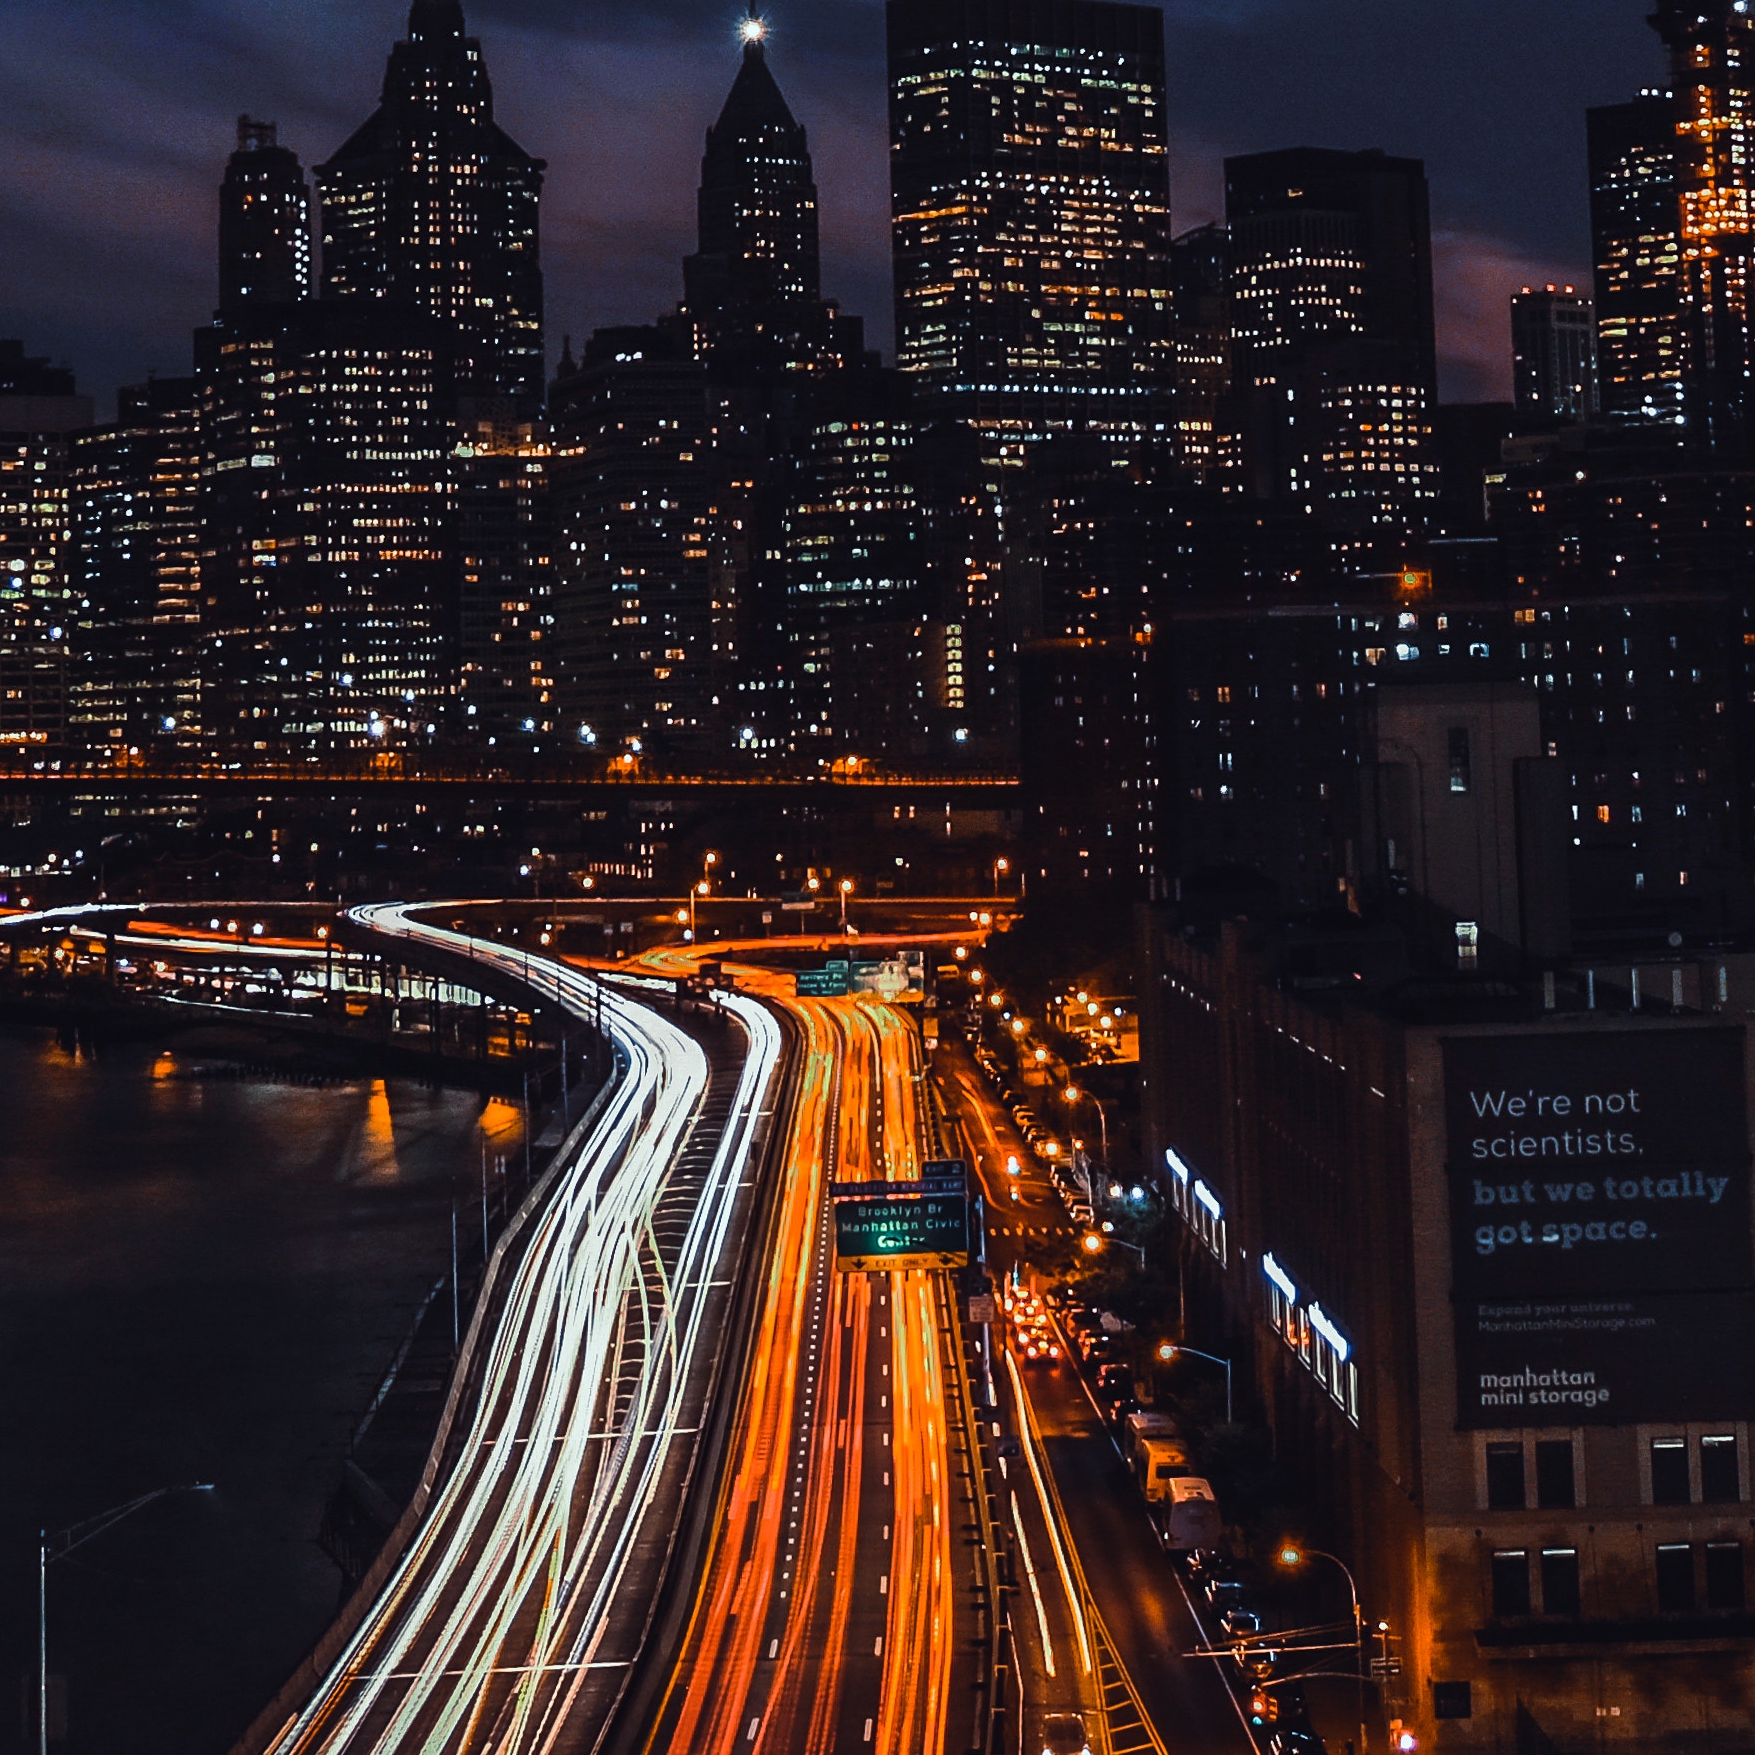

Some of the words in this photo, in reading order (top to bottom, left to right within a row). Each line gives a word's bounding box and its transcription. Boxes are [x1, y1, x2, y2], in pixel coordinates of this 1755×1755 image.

[1470, 1089, 1572, 1118] We're
[1584, 1088, 1641, 1114] not
[1472, 1128, 1644, 1158] scientists,
[951, 1163, 961, 1173] 2
[1473, 1178, 1536, 1205] but
[1543, 1180, 1596, 1202] we
[1603, 1170, 1730, 1205] totally
[858, 1205, 921, 1218] Brooklyn
[928, 1203, 943, 1214] Br
[842, 1220, 919, 1232] Manhattan
[926, 1218, 960, 1229] Civic
[1474, 1220, 1534, 1255] got
[1542, 1219, 1658, 1250] space.
[1478, 1303, 1532, 1317] Expand
[1534, 1303, 1567, 1316] your
[1480, 1364, 1596, 1388] manhattan
[1481, 1388, 1525, 1406] mini
[1528, 1388, 1610, 1408] storage
